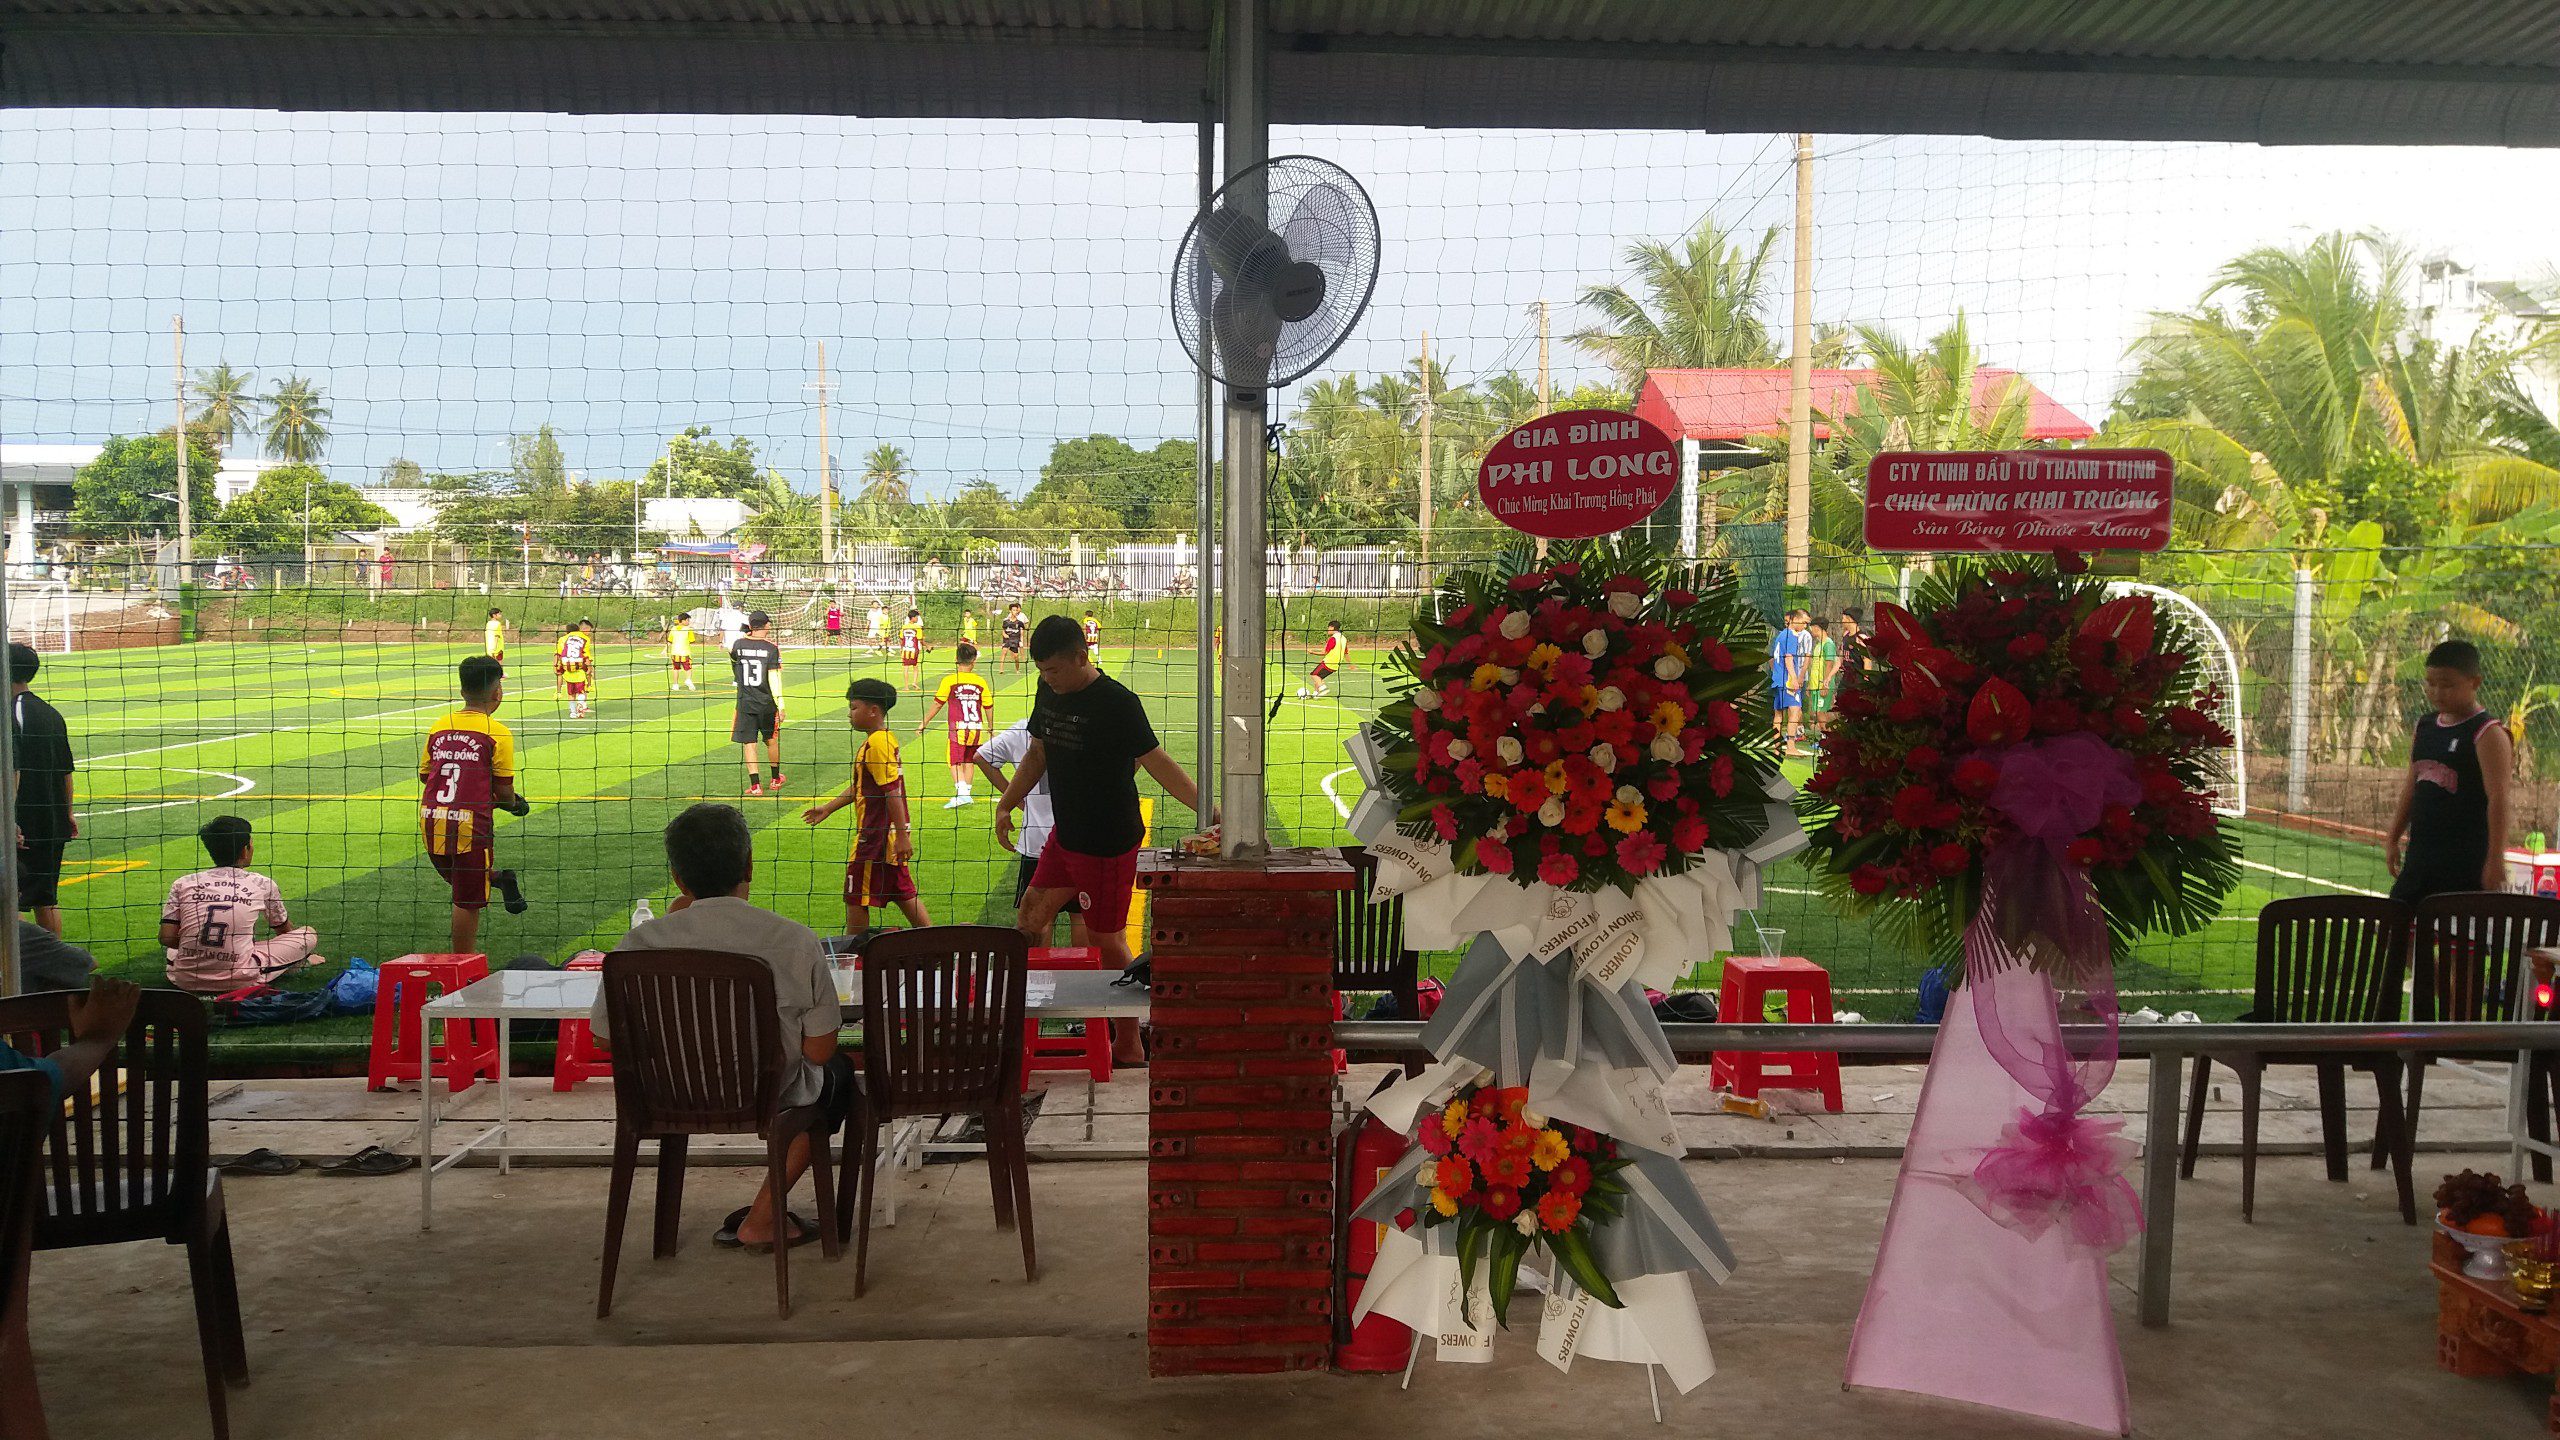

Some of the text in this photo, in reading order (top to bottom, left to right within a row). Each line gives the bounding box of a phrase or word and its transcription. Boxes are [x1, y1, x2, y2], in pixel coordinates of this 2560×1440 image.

[1513, 419, 1640, 449] GIA ĐÌNH
[1487, 451, 1673, 488] PHI LONG
[1889, 456, 2157, 483] CTY TNHH ĐẦU TƯ THANH THỊNH
[1497, 483, 1657, 516] Chúc Mừng Khai Trương Hồng Phát
[1885, 488, 2159, 512] CHÚC MỪNG KHAI TRƯƠNG
[1912, 520, 2151, 539] Sân Bóng Phước Khang
[740, 659, 762, 687] 13
[961, 700, 980, 721] 13
[432, 748, 480, 761] CỘNG ĐỒNG
[436, 763, 461, 803] 3
[1372, 843, 1420, 870] FLOWERS
[199, 905, 230, 948] 6
[1539, 917, 1589, 956] FLOWERS
[1598, 932, 1640, 982] FLOWERS
[1558, 1305, 1585, 1364] FLOWERS
